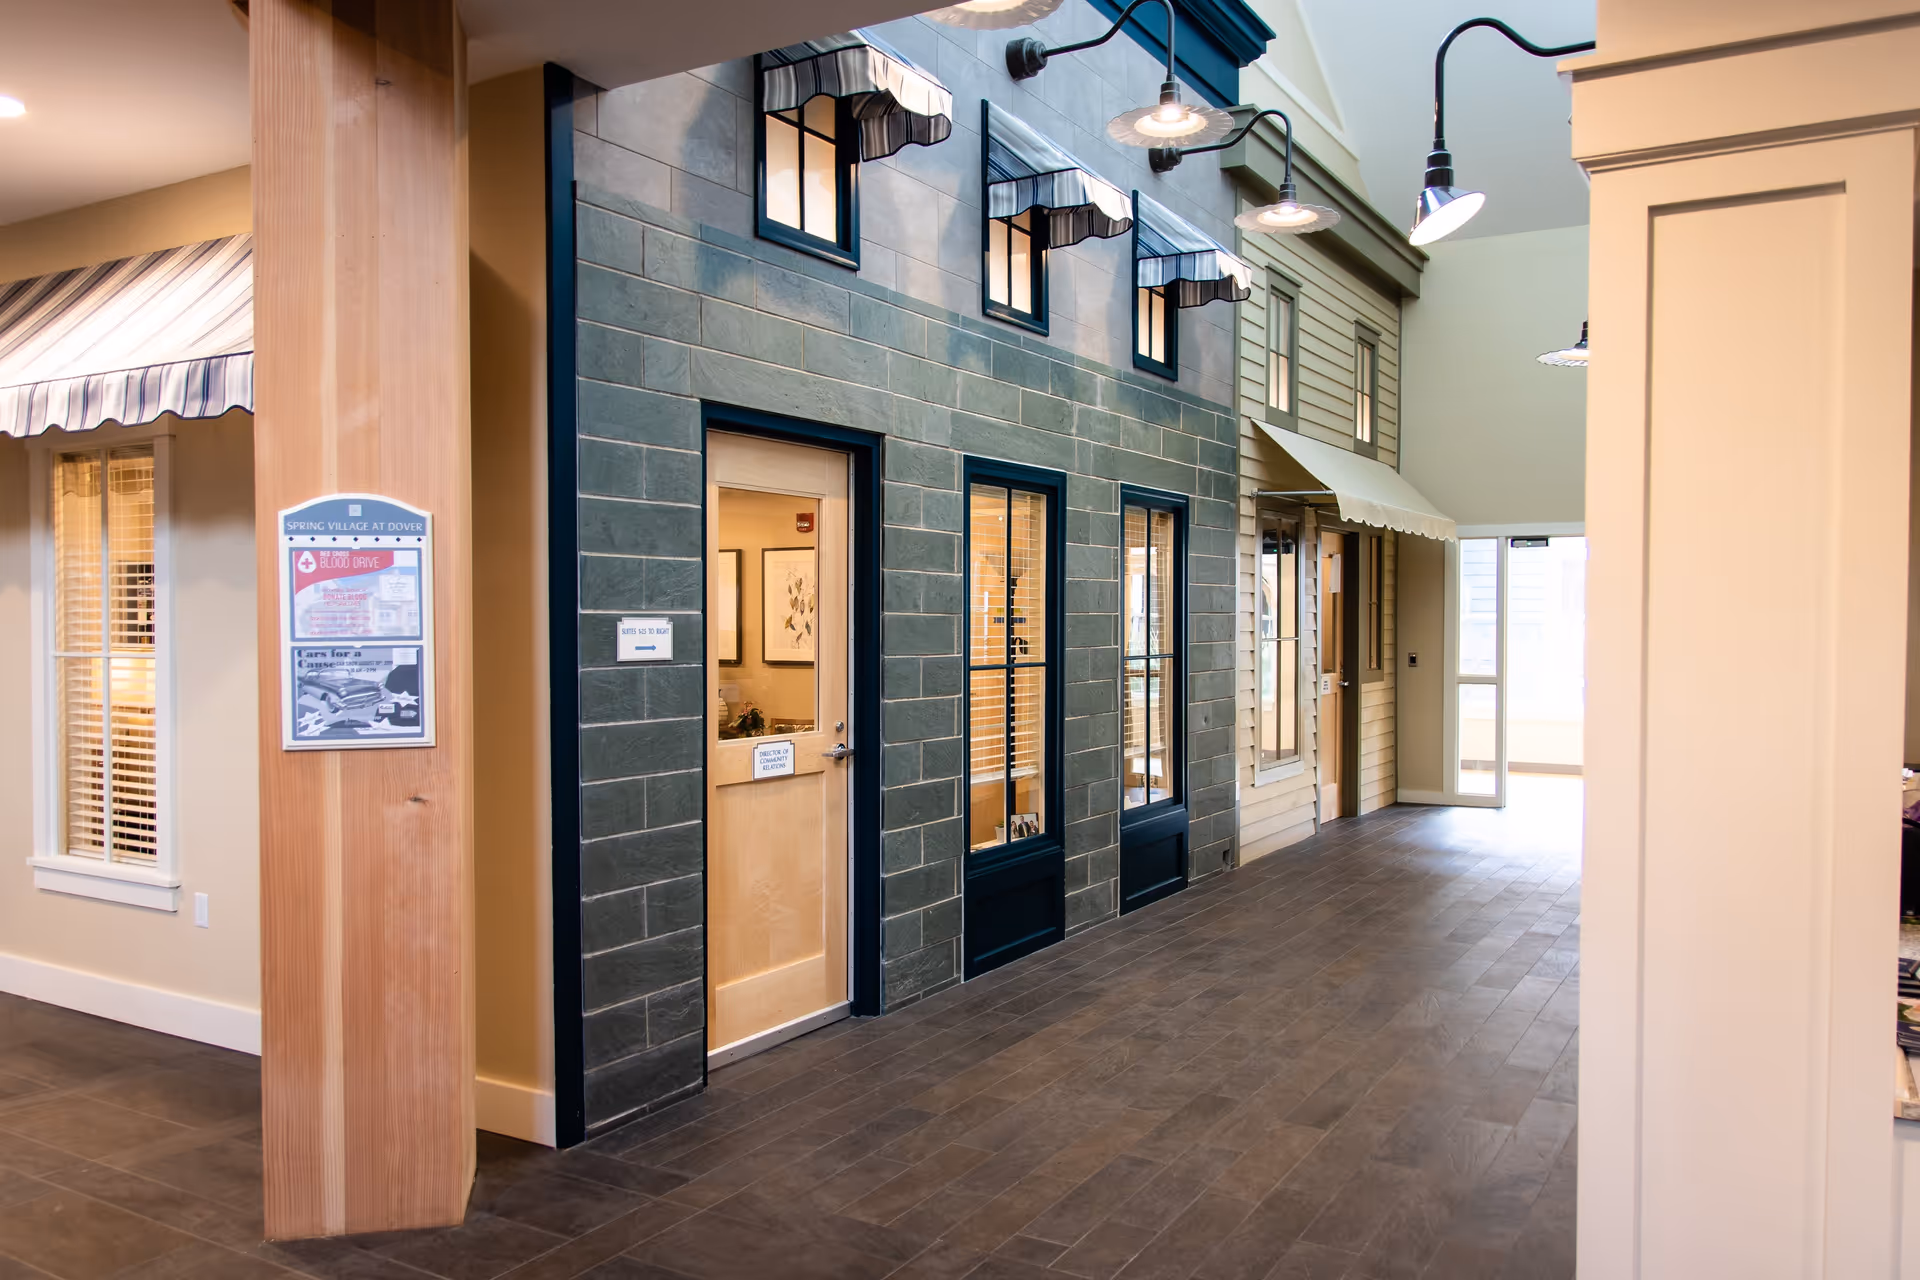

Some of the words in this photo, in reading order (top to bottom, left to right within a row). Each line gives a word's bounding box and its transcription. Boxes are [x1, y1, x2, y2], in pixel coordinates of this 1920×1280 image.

[286, 521, 325, 531] SPRING
[328, 521, 369, 531] VILLAGE
[372, 522, 385, 531] AT
[388, 522, 423, 532] DOVER
[320, 556, 350, 569] BLOOD
[353, 556, 380, 569] DRIVE
[621, 627, 637, 635] SUITES
[648, 627, 655, 635] TO
[656, 627, 670, 635] RIGHT
[297, 649, 327, 658] Cars
[331, 649, 351, 658] for
[297, 659, 337, 669] Cause
[759, 749, 781, 758] DIRECTOR
[759, 755, 788, 765] COMMUNITY
[762, 762, 786, 771] RELATIONS
